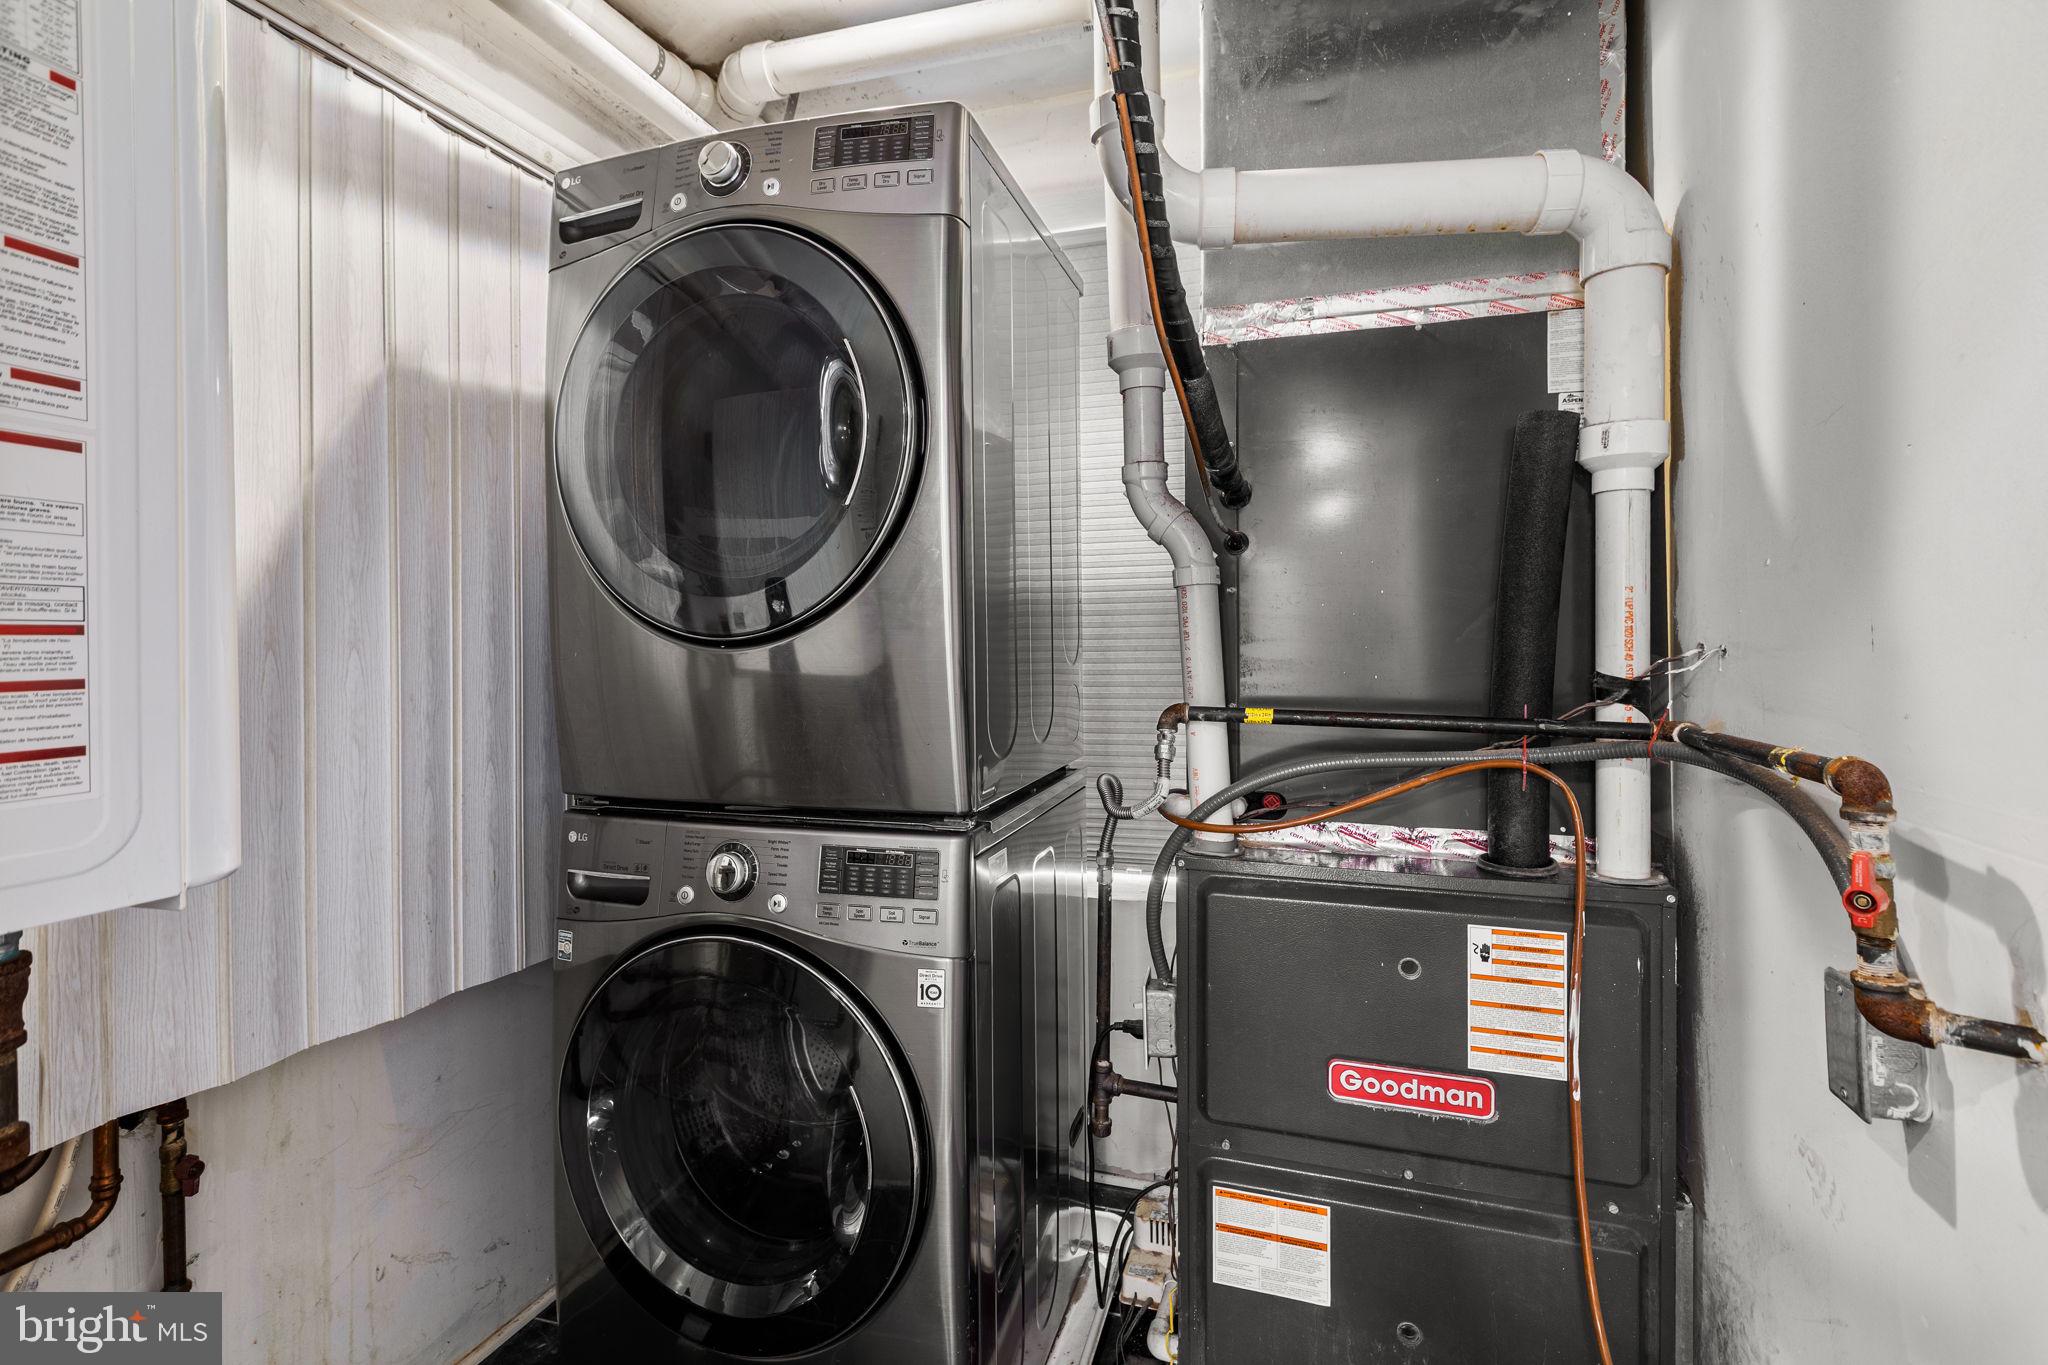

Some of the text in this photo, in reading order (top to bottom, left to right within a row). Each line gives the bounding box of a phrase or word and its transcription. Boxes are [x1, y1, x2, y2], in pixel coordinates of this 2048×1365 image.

[571, 176, 582, 186] LG
[1624, 611, 1634, 624] PVC
[578, 832, 588, 842] LG
[918, 913, 931, 921] Signal
[920, 983, 943, 1001] 10
[1339, 1069, 1483, 1109] Goodman
